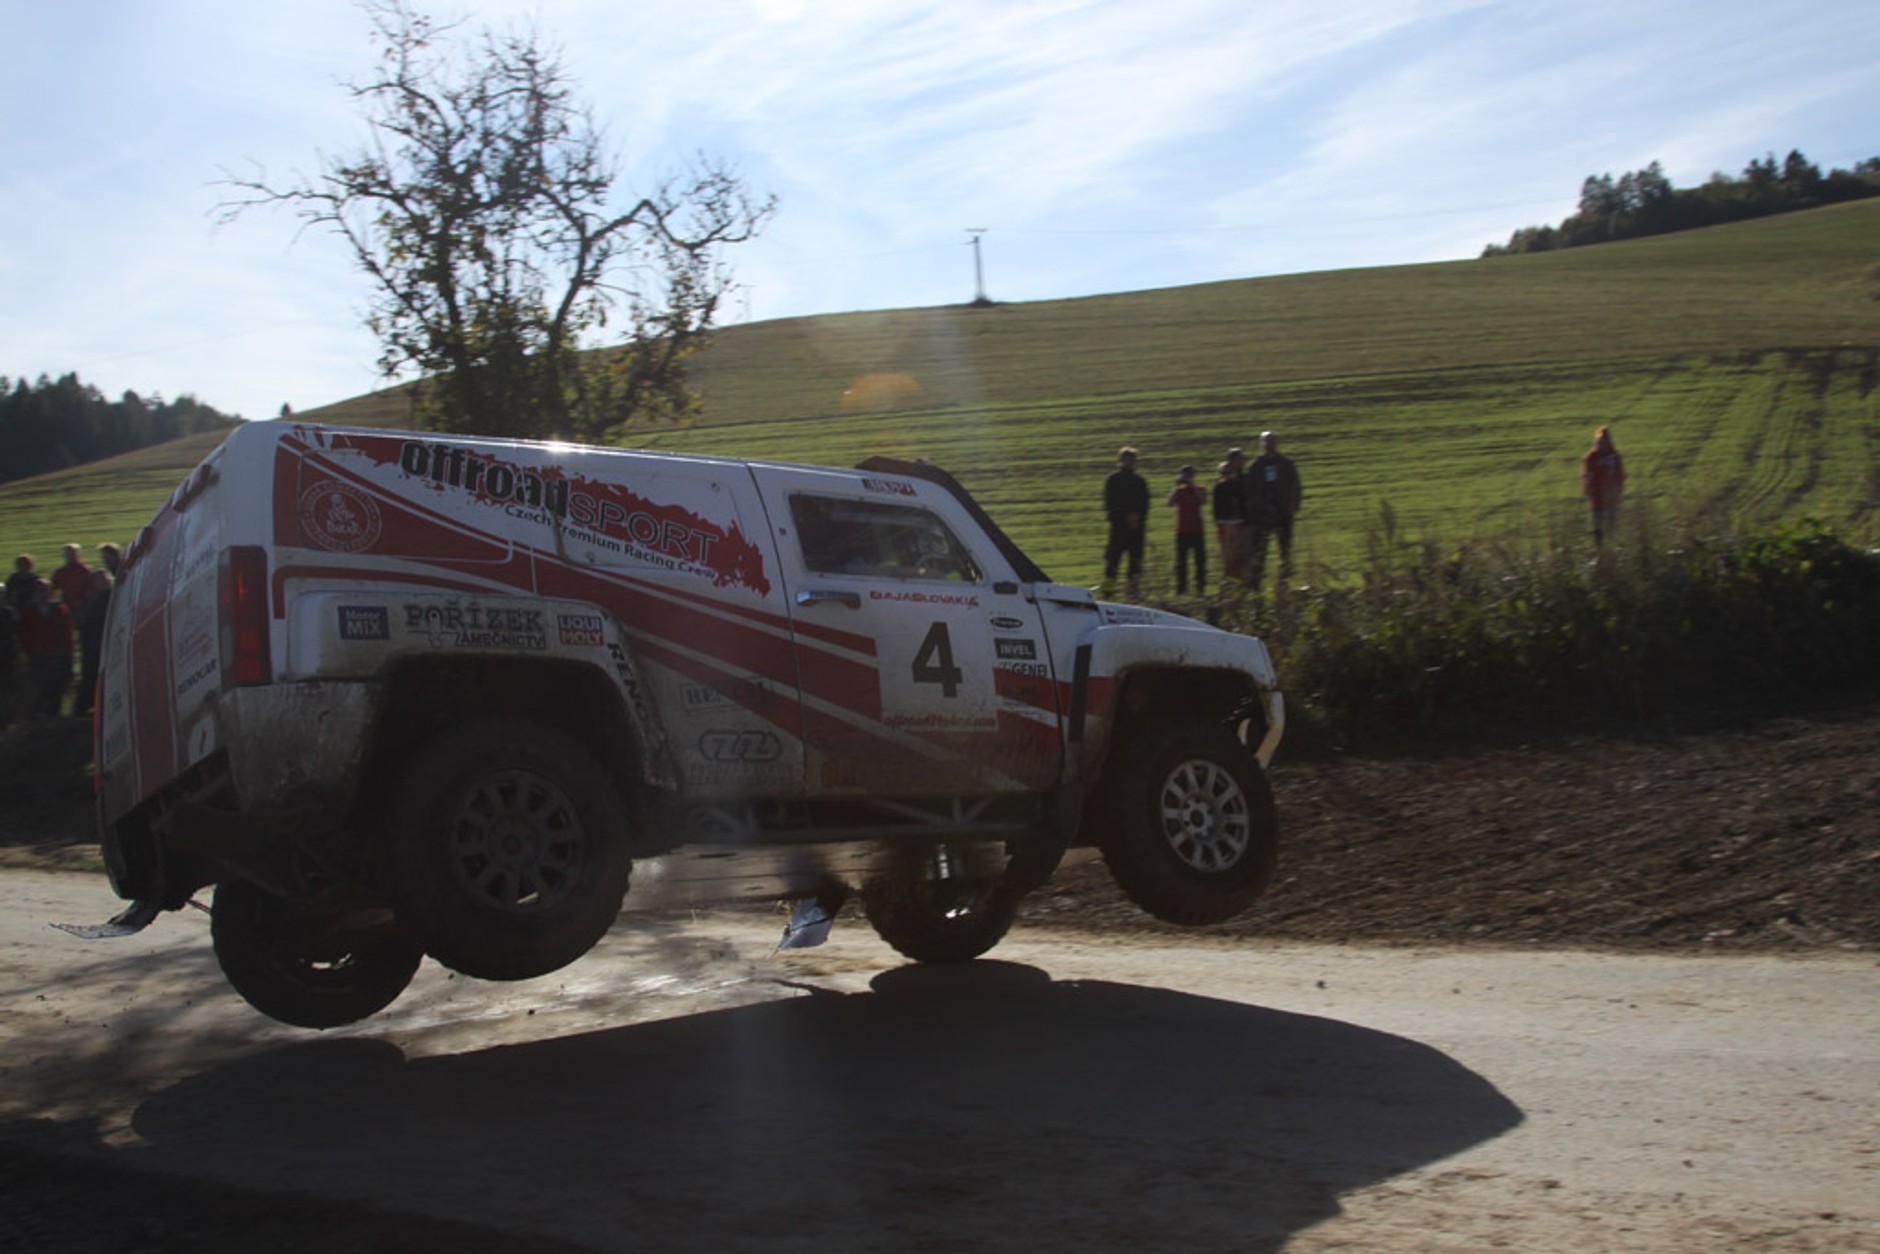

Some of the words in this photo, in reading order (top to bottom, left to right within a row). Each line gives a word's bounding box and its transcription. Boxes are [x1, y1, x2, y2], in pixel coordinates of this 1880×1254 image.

[504, 503, 551, 526] Czech
[557, 521, 621, 553] remium
[624, 542, 675, 571] Racing
[677, 561, 716, 580] Crew
[911, 621, 964, 698] 4
